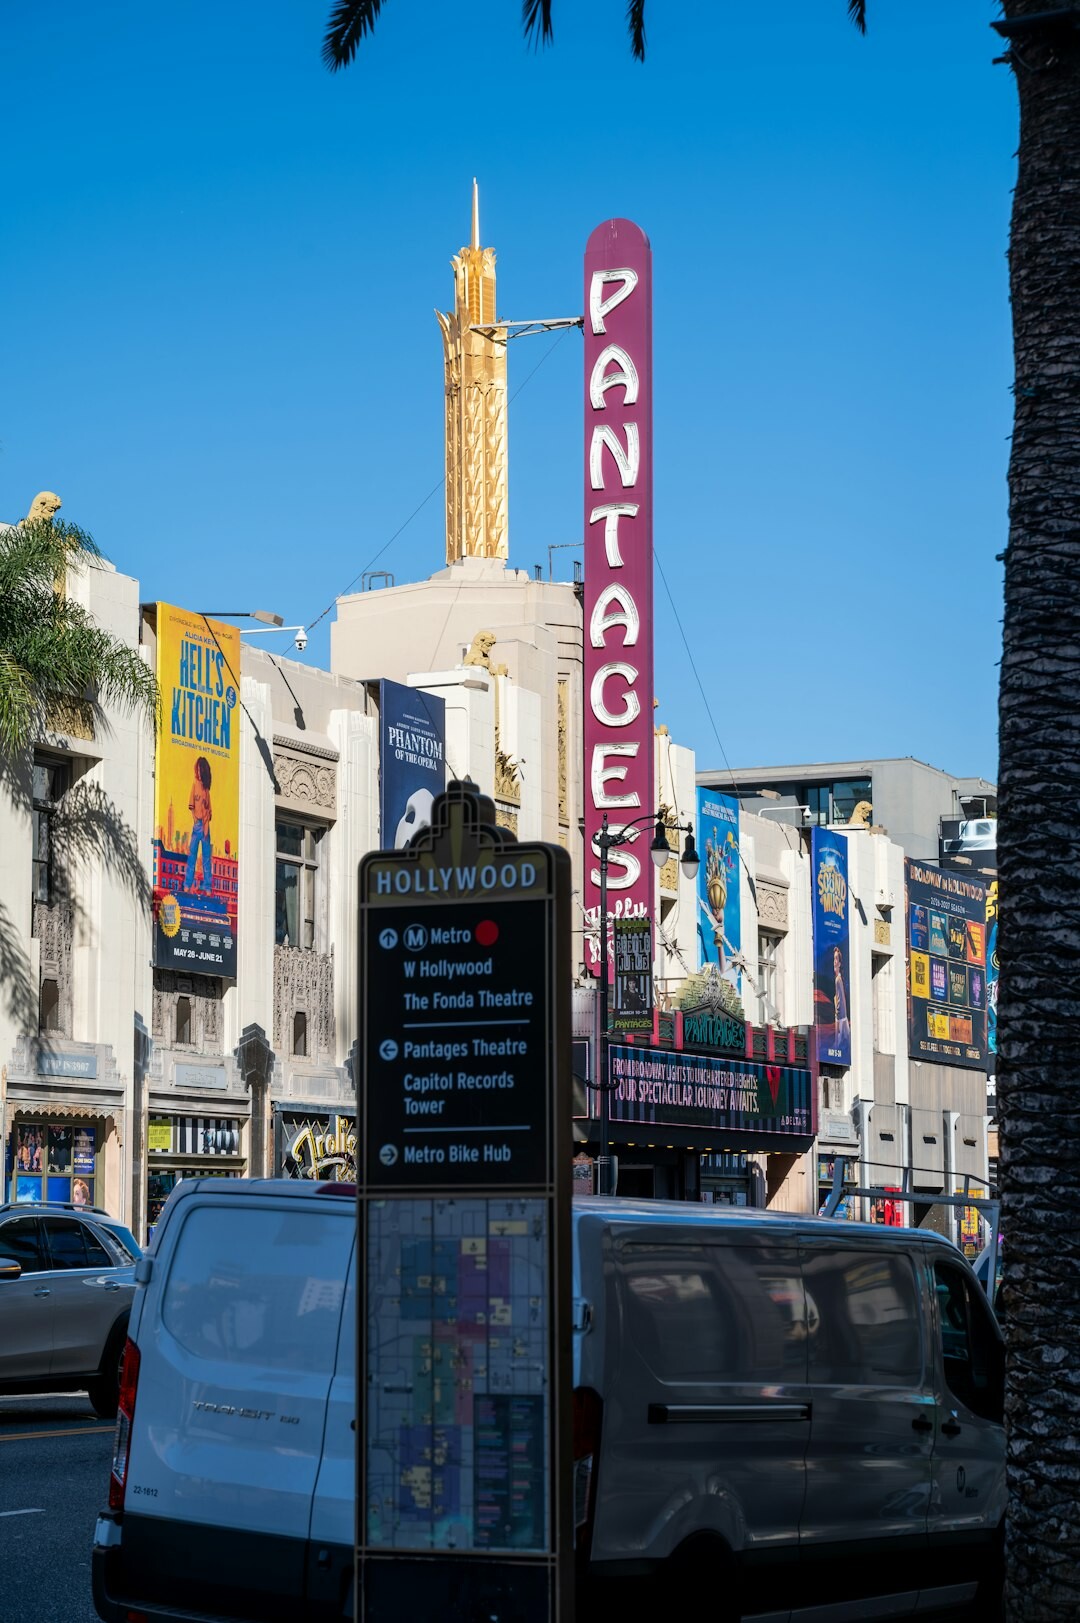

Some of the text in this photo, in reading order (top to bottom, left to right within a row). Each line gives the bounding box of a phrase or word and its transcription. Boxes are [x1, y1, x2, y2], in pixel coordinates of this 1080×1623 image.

[589, 267, 640, 890] PANTAGES
[185, 631, 202, 642] ALICIA
[180, 640, 224, 698] HELL'S
[171, 687, 231, 749] KITCHEN
[211, 749, 230, 759] MUSICAL
[388, 726, 443, 761] PHANTOM
[395, 748, 438, 771] OF THE OPERA
[377, 863, 536, 894] HOLLYWOOD
[817, 870, 846, 901] SOUND
[910, 865, 942, 888] BROADWAY
[948, 877, 983, 902] HOLLYWOOD
[823, 893, 845, 920] MUSIC
[430, 927, 472, 945] Metro
[173, 948, 187, 957] MAY
[198, 951, 215, 962] JUNE
[215, 954, 223, 963] 21
[403, 957, 493, 980] W Hollywood
[403, 989, 533, 1010] The Fonda Theatre
[614, 1020, 653, 1029] PANTAGES
[684, 1012, 745, 1049] PANTAGES
[403, 1038, 527, 1062] Pantages Theatre
[403, 1070, 514, 1094] Capitol Records
[612, 1058, 631, 1076] FROM
[631, 1059, 666, 1080] BROADWAY
[666, 1064, 686, 1083] LIGHTS
[686, 1066, 695, 1083] TO
[695, 1067, 734, 1087] UNCHARTERED
[403, 1097, 445, 1115] Tower
[639, 1080, 694, 1106] SPECTACULAR
[694, 1085, 728, 1110] JOURNEY
[729, 1089, 760, 1113] AWAITS.
[785, 1115, 801, 1126] DELTA
[404, 1143, 511, 1164] Metro Bike Hub
[192, 1400, 276, 1421] TRANSIT
